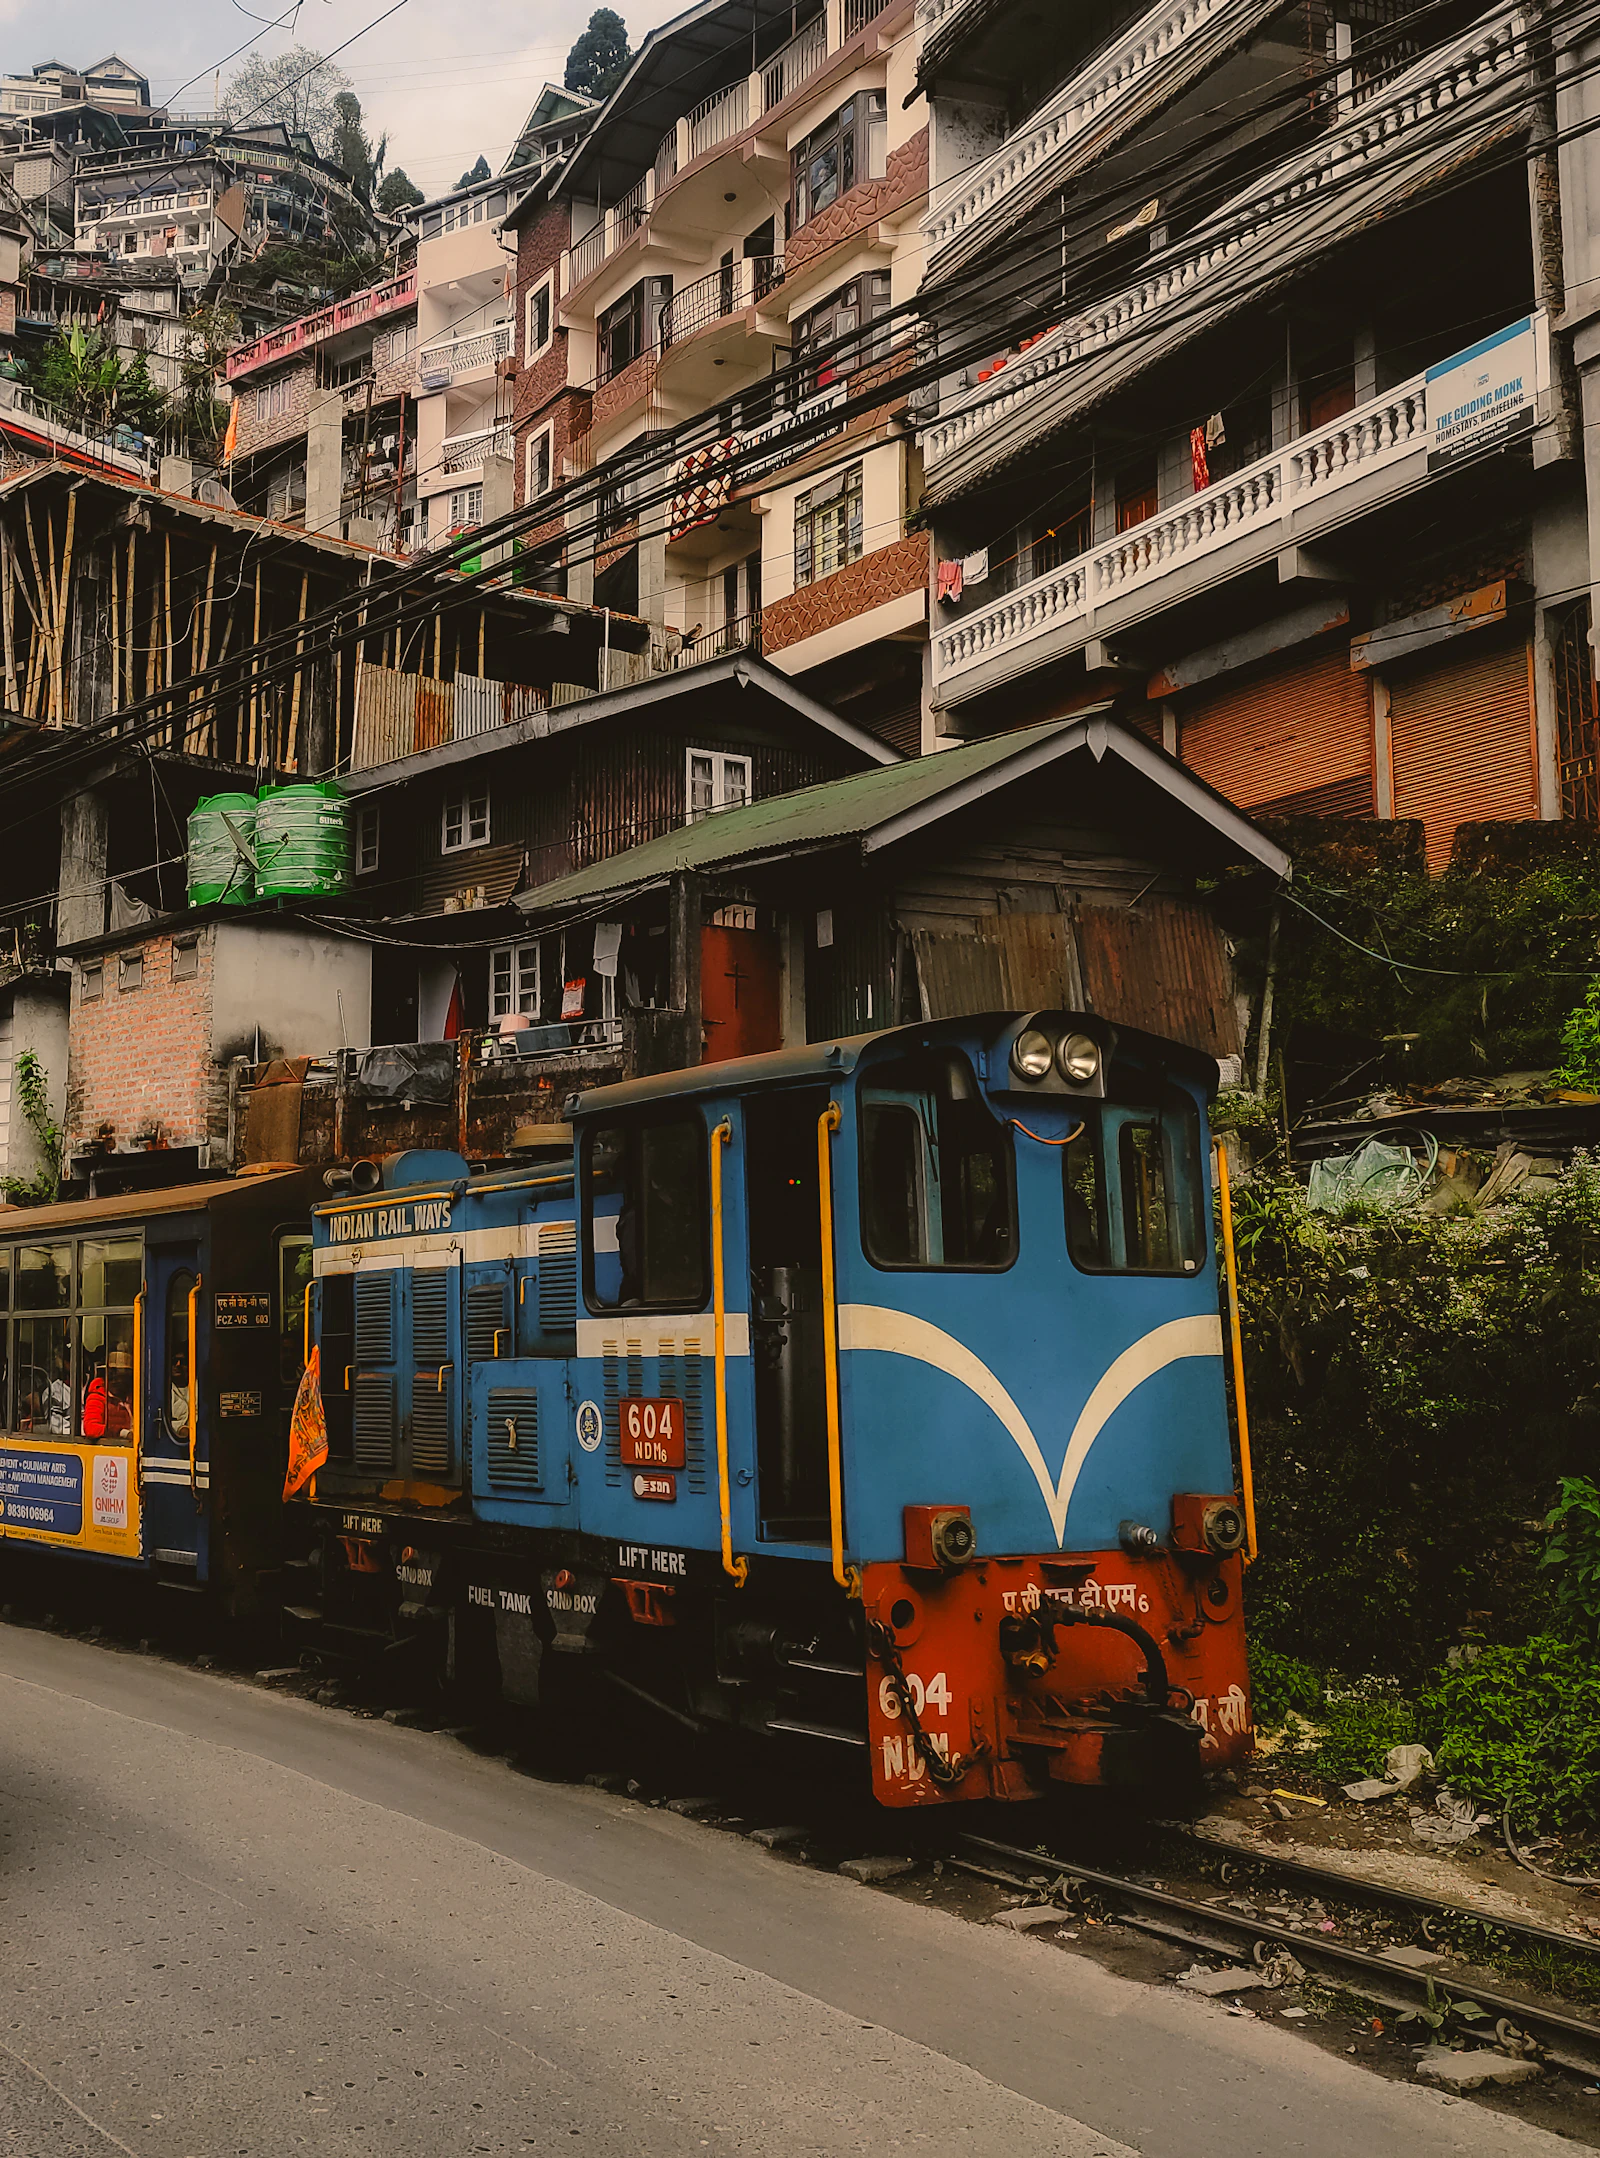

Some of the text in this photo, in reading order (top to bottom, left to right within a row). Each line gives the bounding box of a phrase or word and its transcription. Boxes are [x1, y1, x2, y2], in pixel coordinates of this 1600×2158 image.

[1436, 411, 1452, 431] THE
[1454, 392, 1492, 425] GUIDING
[1494, 376, 1523, 406] MONK
[1435, 416, 1480, 444] HOMESTAYS,
[1480, 393, 1524, 423] DARJEELING
[329, 1212, 374, 1242] INDIAN
[628, 1404, 673, 1439] 604
[11, 1471, 37, 1484] AVIATION
[37, 1474, 78, 1489] MANAGEMENT
[22, 1460, 51, 1472] CULINARY
[51, 1462, 66, 1474] ARTS
[7, 1503, 54, 1523] 9836106964
[95, 1497, 124, 1514] GNIHM
[342, 1514, 383, 1534] LIFT HERE
[618, 1545, 687, 1576] LIFT HERE
[396, 1564, 432, 1586] SAND BOX
[468, 1585, 532, 1615] FUEL TANK
[546, 1589, 597, 1614] SAND BOX
[878, 1672, 952, 1720] 604
